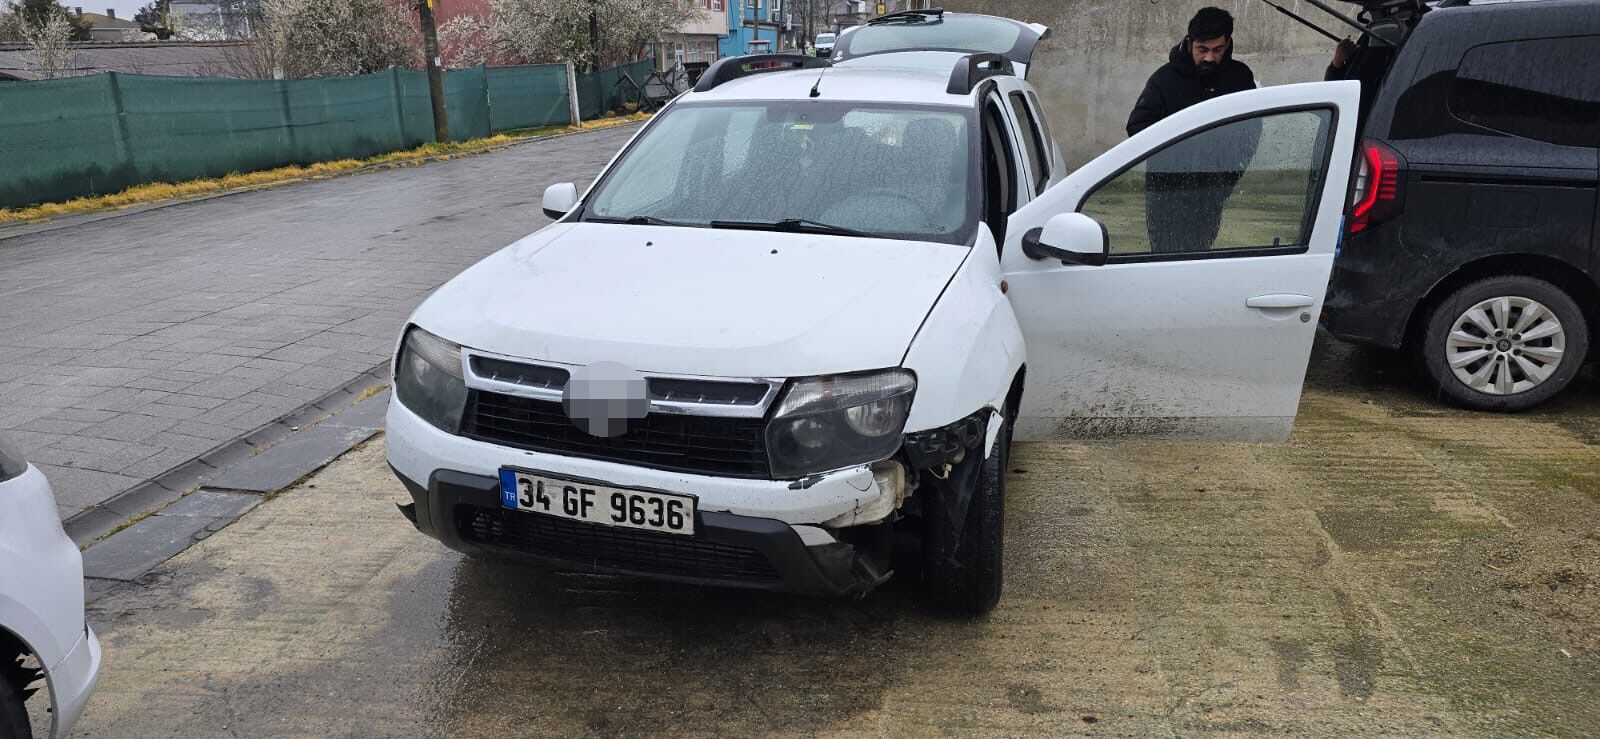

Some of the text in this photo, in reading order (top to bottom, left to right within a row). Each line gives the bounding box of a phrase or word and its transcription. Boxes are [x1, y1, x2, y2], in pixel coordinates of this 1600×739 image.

[504, 491, 516, 501] TR
[518, 477, 684, 530] 34 GF 9636
